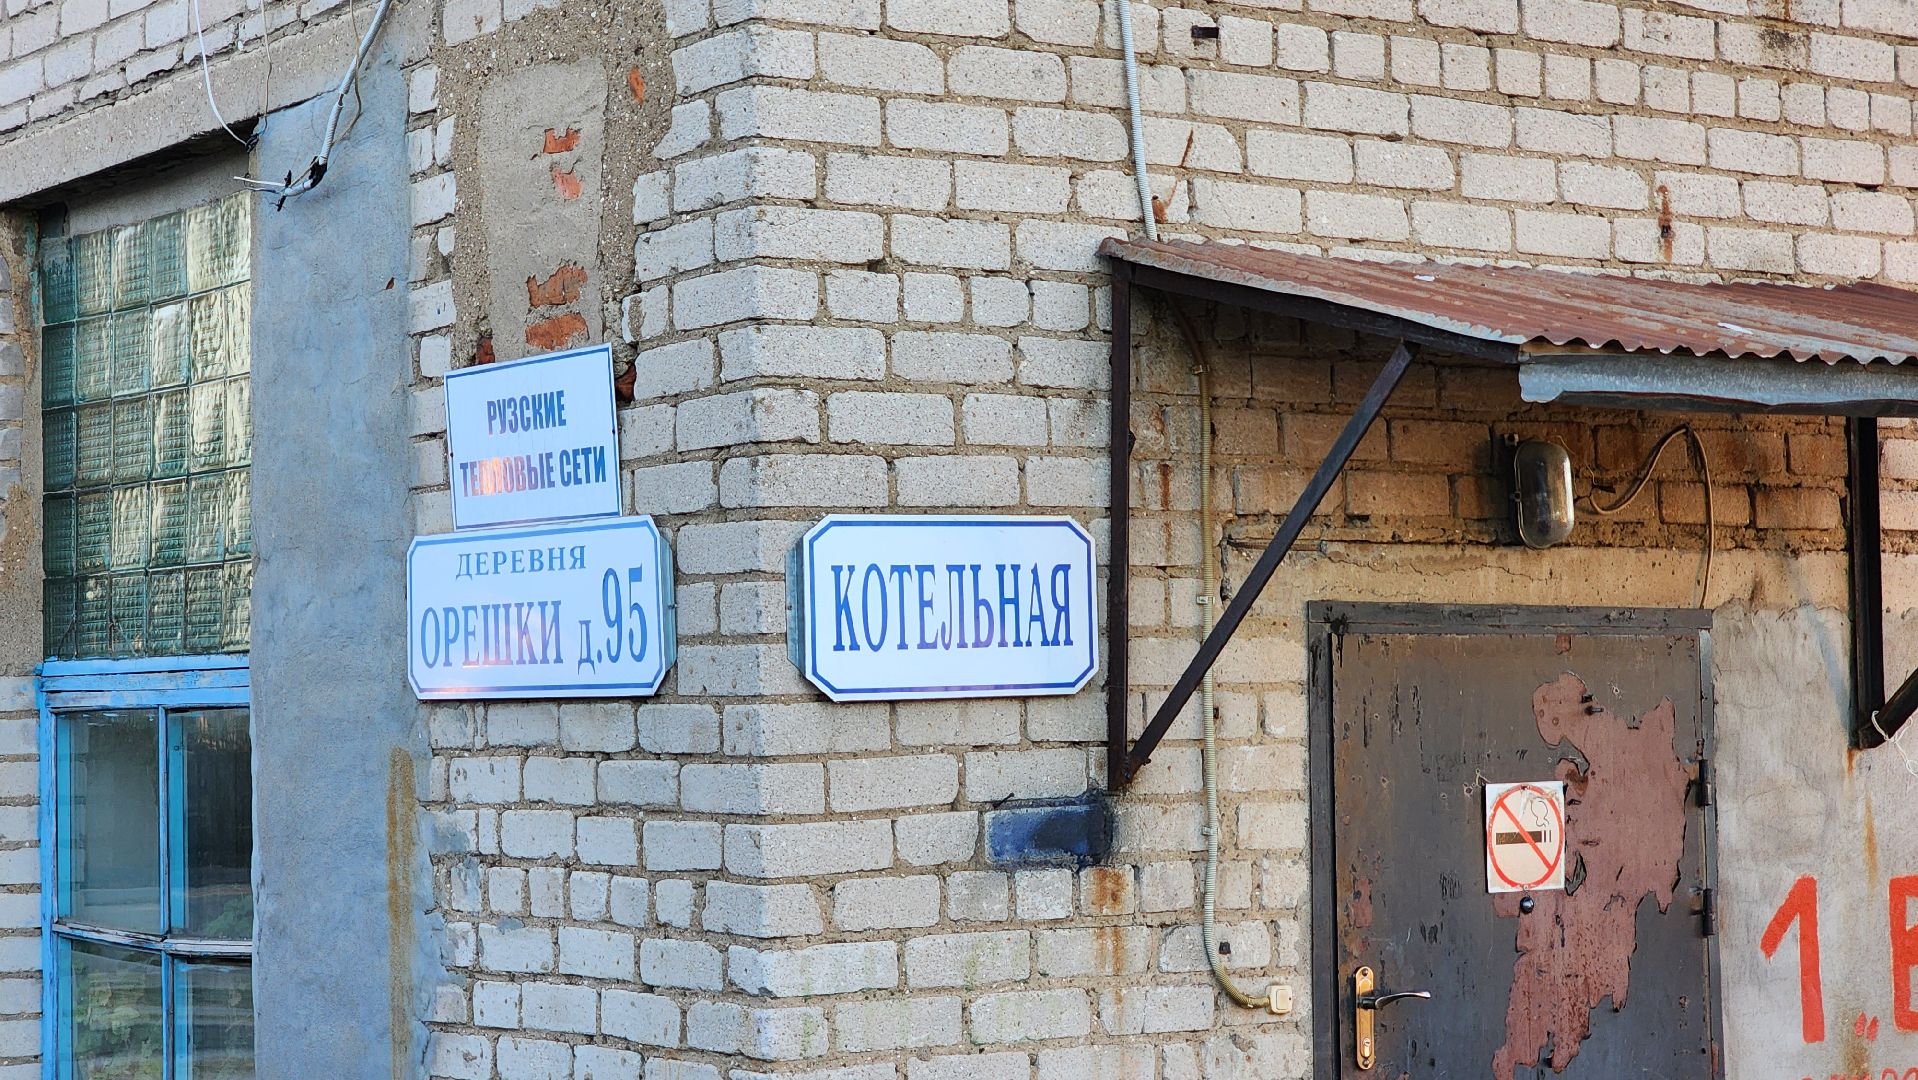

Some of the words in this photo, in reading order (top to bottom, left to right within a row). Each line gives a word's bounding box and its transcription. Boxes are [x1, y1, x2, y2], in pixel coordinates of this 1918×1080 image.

[486, 390, 567, 435] РУЗСКИЕ
[459, 452, 556, 497] ТЕПЛОВЫЕ
[558, 445, 607, 488] СЕТИ
[455, 545, 587, 580] ДЕРЕВНЯ
[420, 600, 564, 669] ОРЕШКИ
[830, 562, 1074, 652] КОТЕЛЬНАЯ
[1760, 874, 1824, 1043] 1
